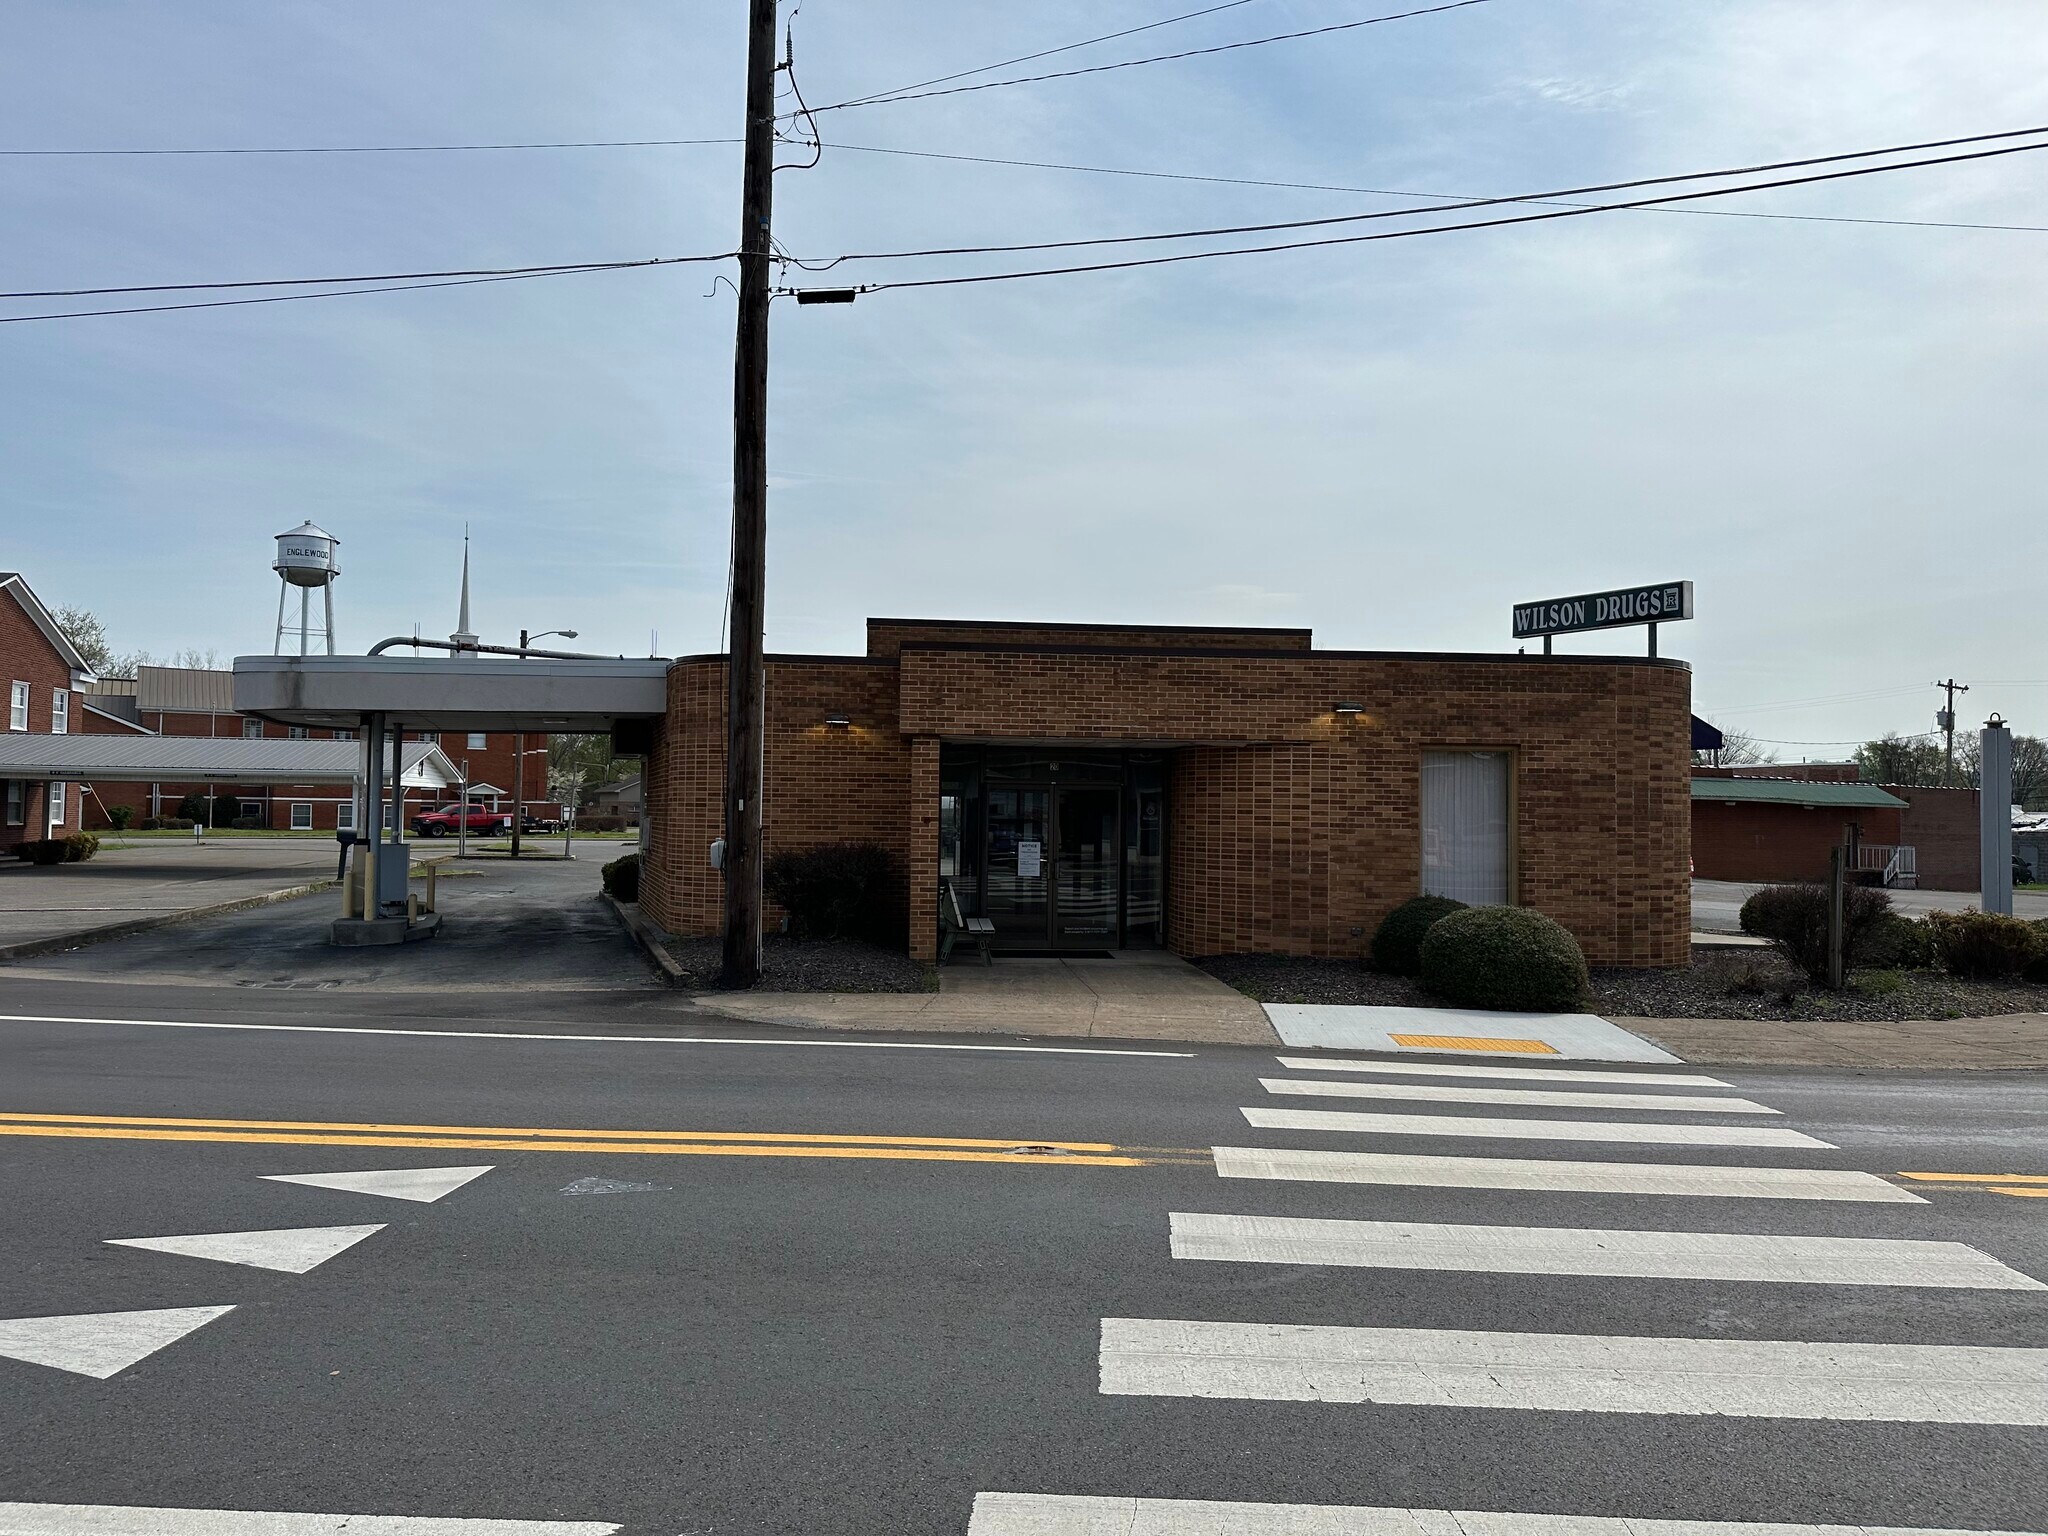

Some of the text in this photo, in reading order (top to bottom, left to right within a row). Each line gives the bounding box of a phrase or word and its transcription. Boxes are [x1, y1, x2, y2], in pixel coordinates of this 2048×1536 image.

[287, 548, 329, 559] ENGLEWOOD
[1515, 590, 1661, 632] WILSON DRUGS
